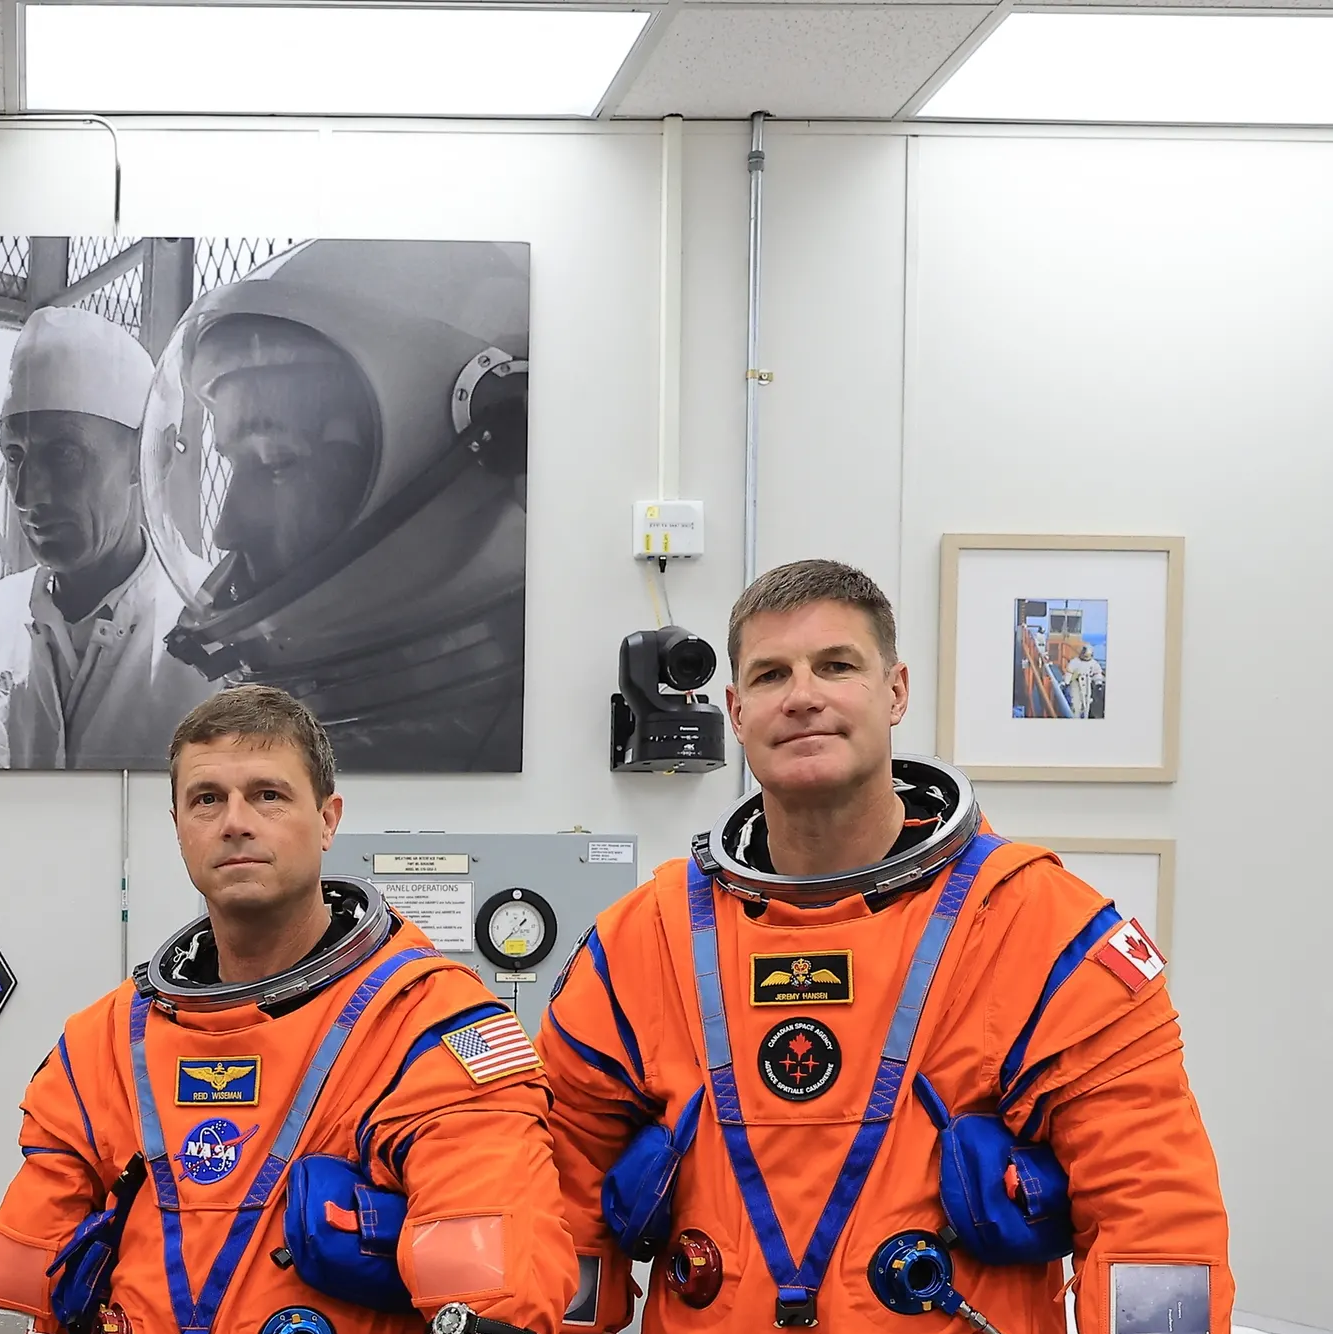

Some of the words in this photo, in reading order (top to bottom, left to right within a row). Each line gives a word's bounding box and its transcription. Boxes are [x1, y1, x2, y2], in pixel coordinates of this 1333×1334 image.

[386, 884, 410, 892] PANEL
[411, 884, 458, 892] OPERATIONS
[802, 992, 828, 1000] HANSEN
[768, 1024, 794, 1048] CANADIAN
[794, 1023, 815, 1031] SPACE
[814, 1028, 833, 1050] AGENCY
[764, 1060, 778, 1085] AGENCE
[776, 1081, 804, 1094] SPATIALE
[806, 1063, 834, 1093] CANADIENNE
[193, 1092, 208, 1100] REID
[212, 1092, 242, 1100] WISEMAN
[185, 1141, 236, 1161] NASA
